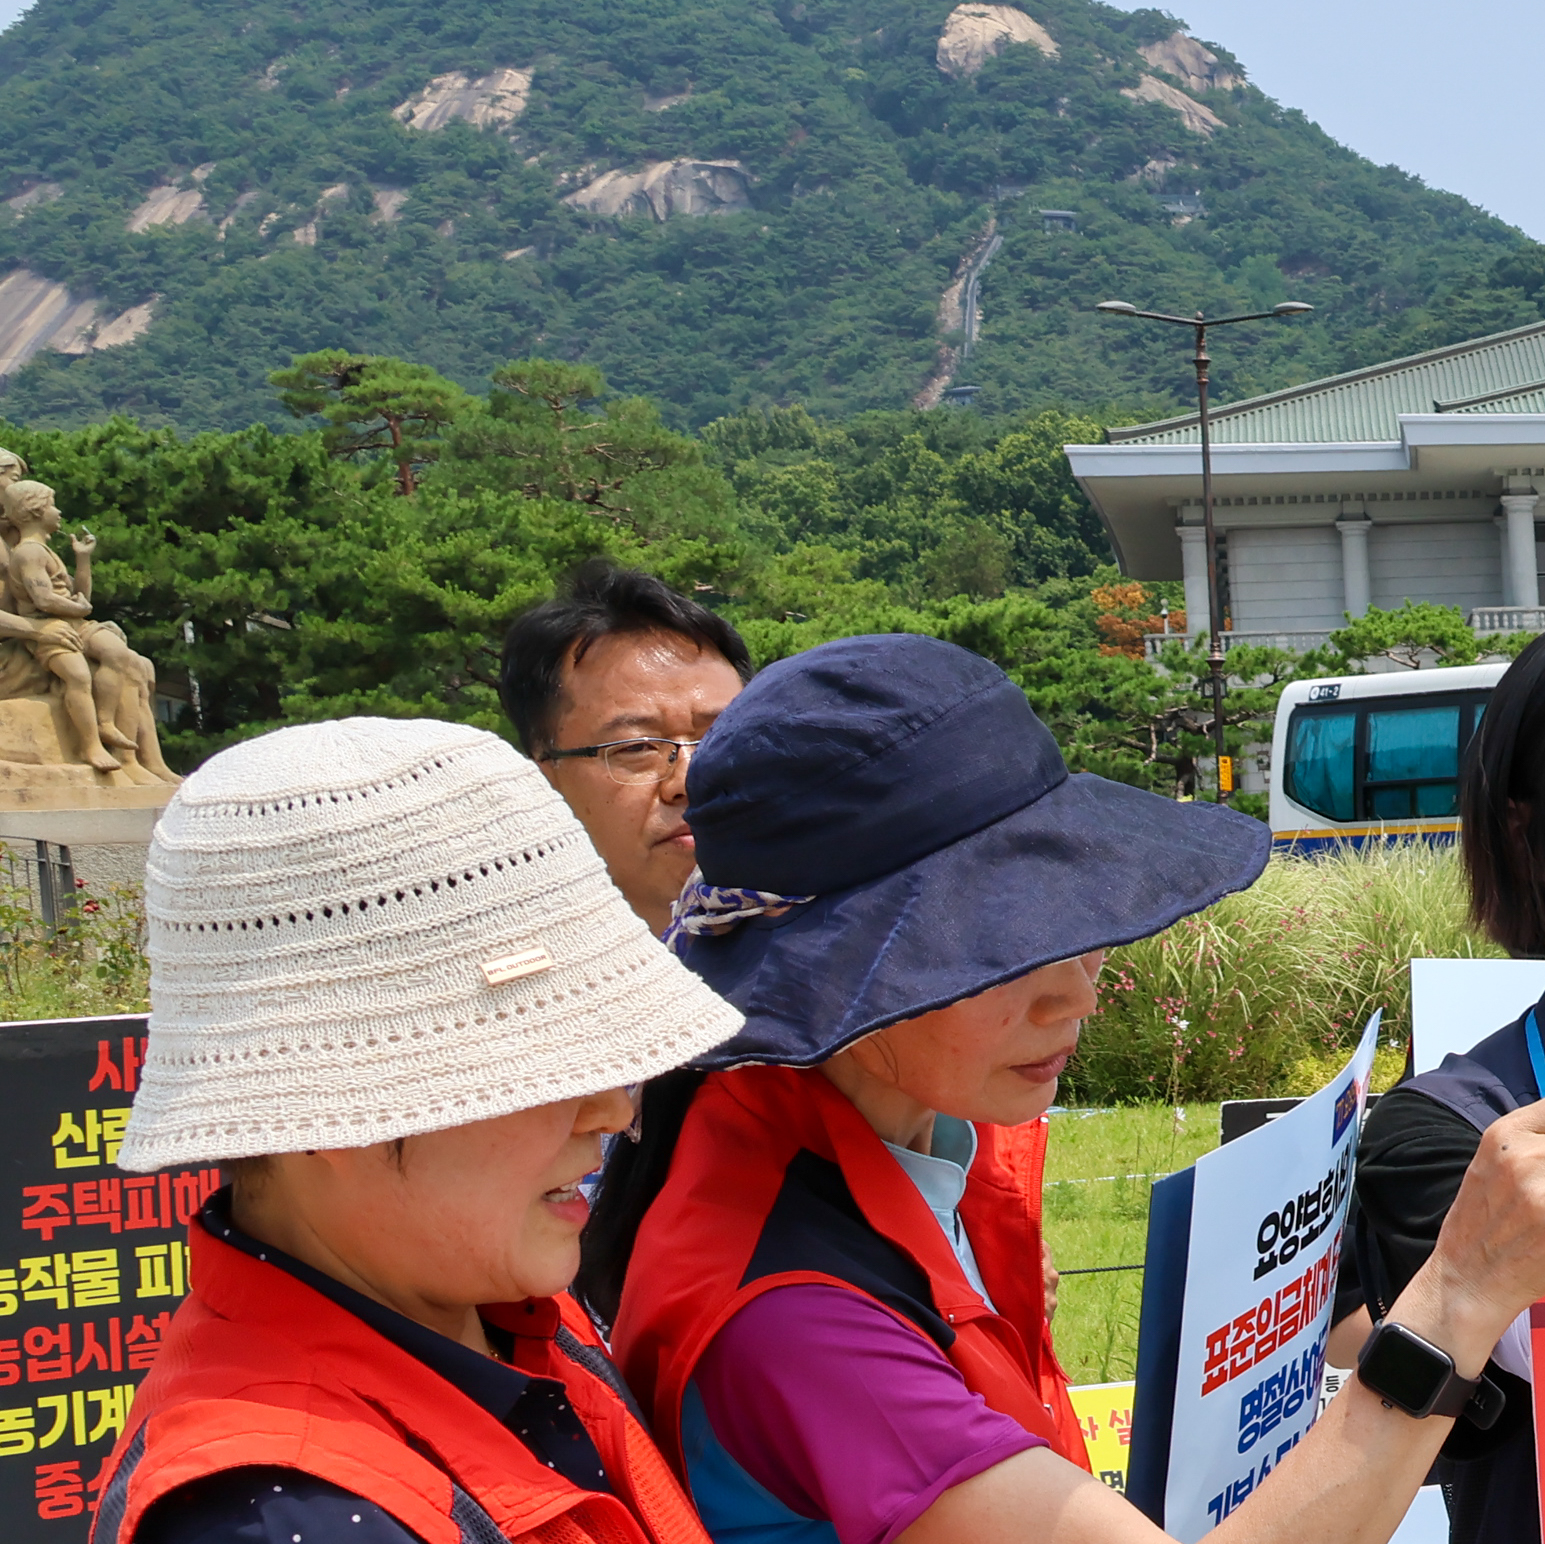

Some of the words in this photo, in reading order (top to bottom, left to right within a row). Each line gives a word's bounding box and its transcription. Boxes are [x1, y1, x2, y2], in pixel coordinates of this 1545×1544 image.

[506, 954, 548, 970] OUTDOOR
[22, 1168, 221, 1241] 주택피해
[135, 1241, 192, 1298] 피
